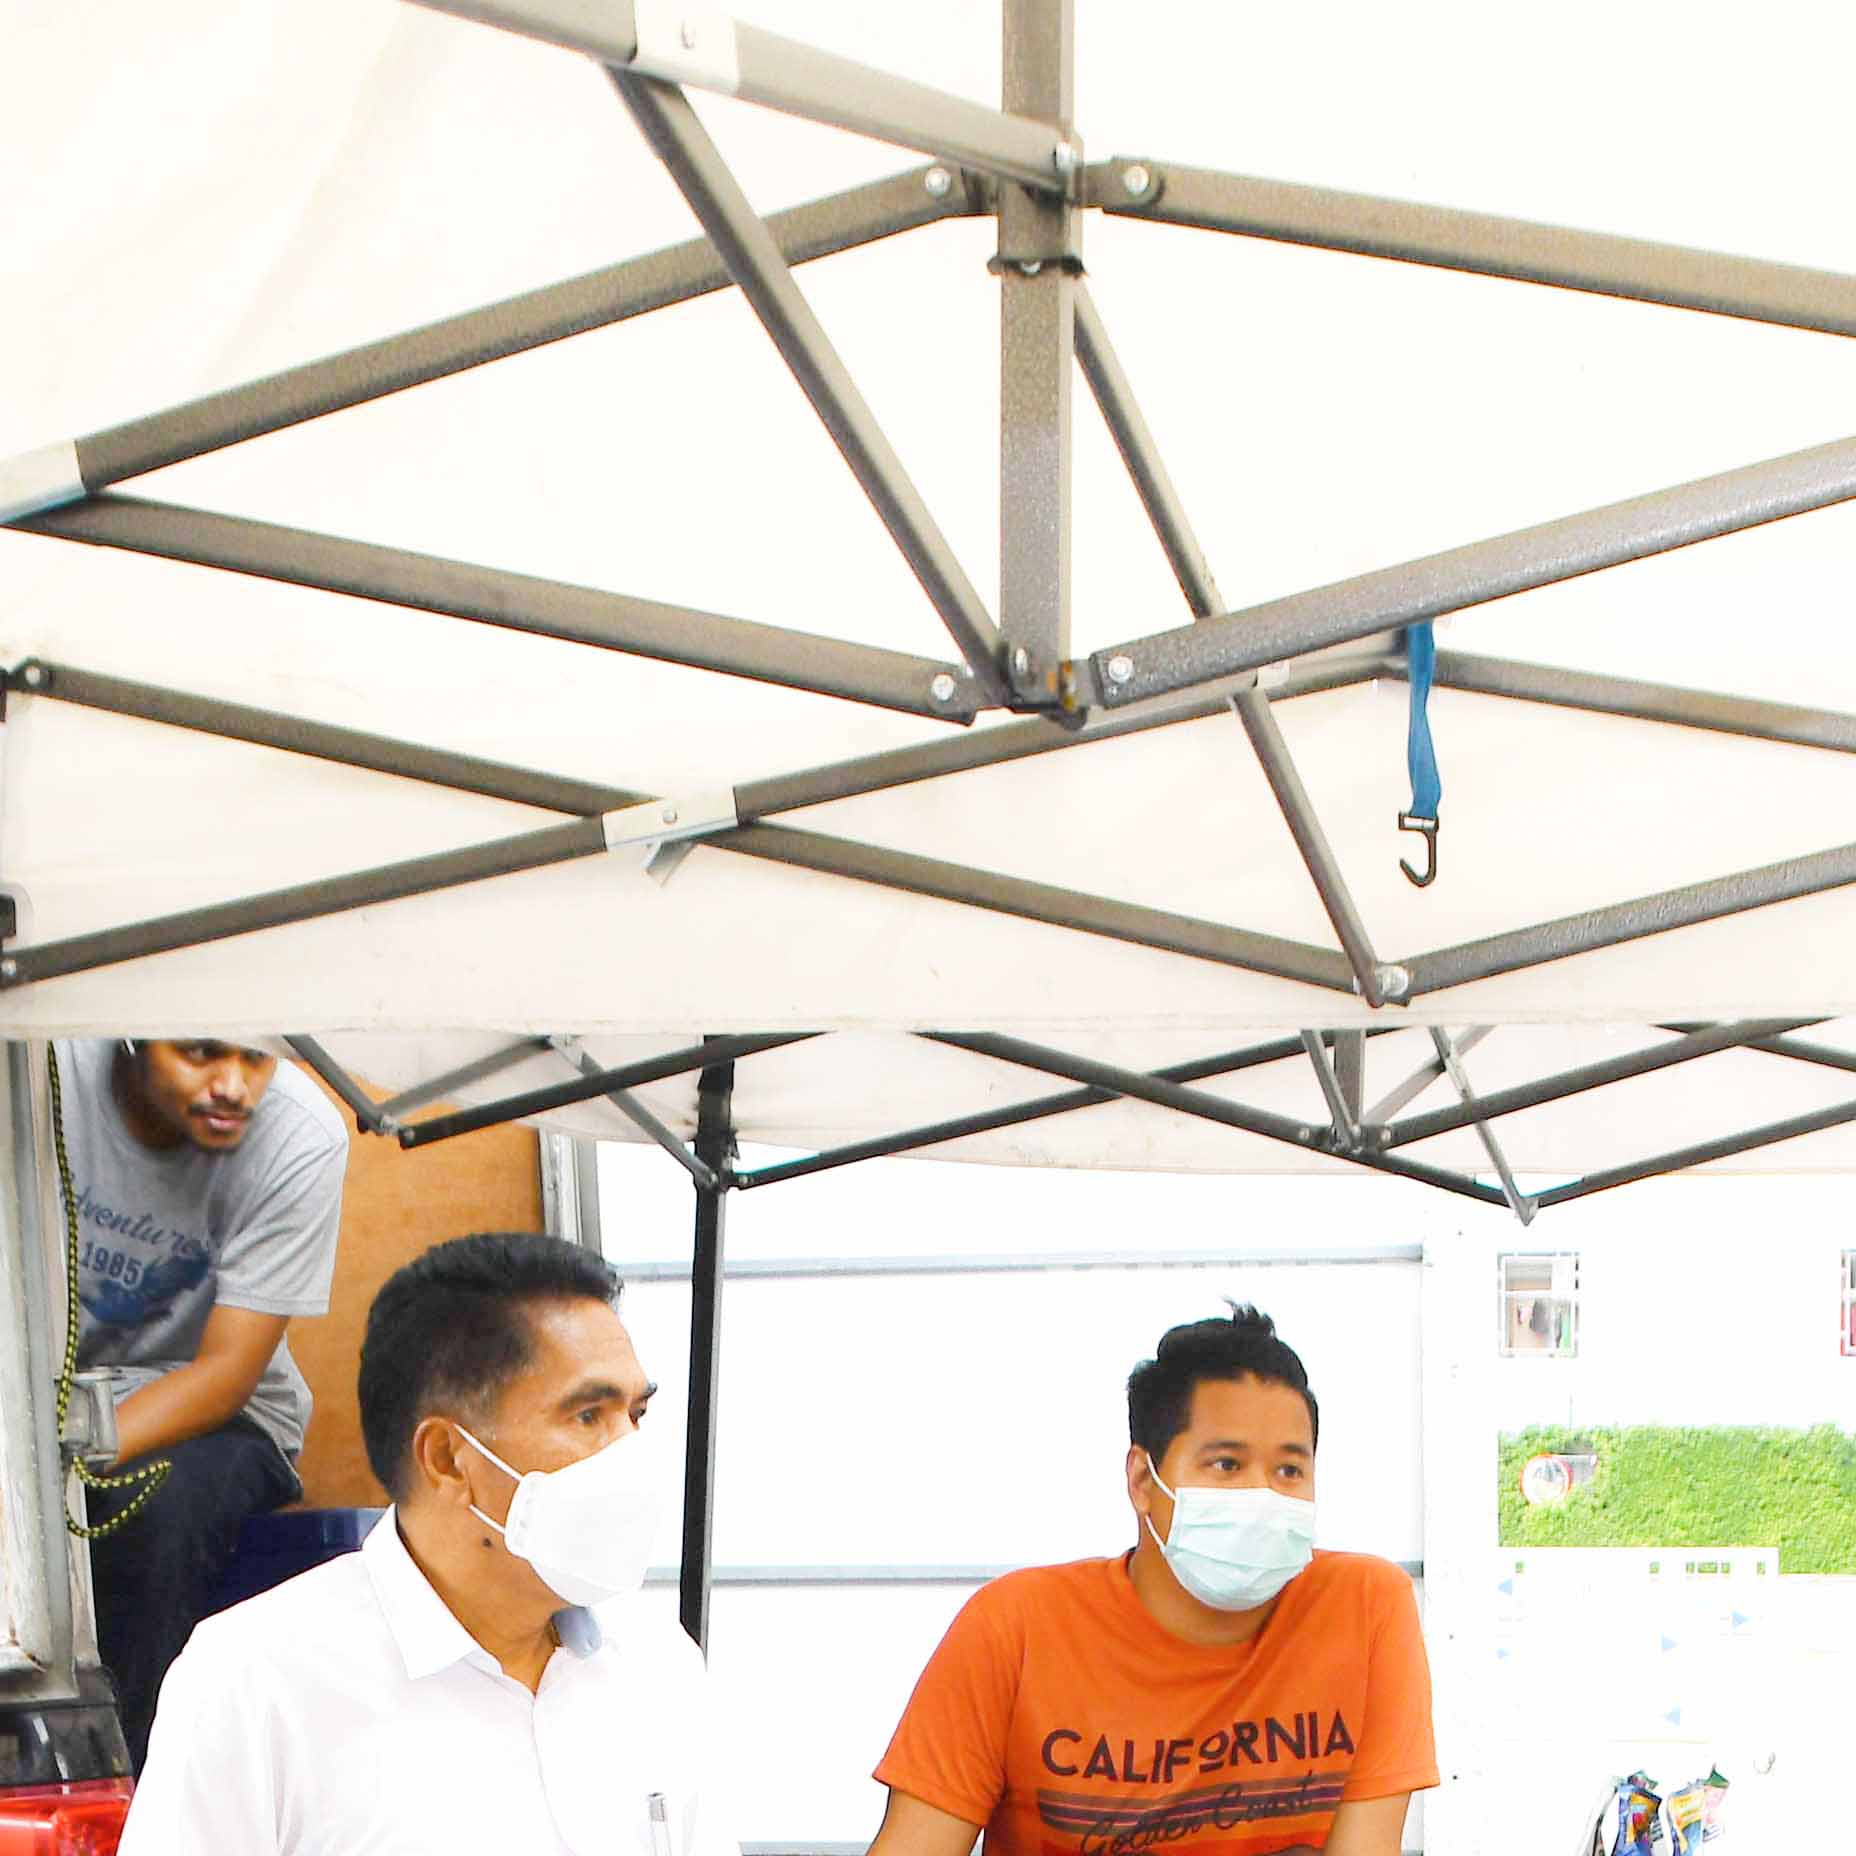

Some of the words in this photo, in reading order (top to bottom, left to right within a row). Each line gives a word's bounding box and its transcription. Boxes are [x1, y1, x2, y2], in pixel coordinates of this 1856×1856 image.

[80, 1241, 143, 1286] 1985
[1041, 1709, 1355, 1784] CALIFORNIA
[1212, 1769, 1314, 1831] Coast
